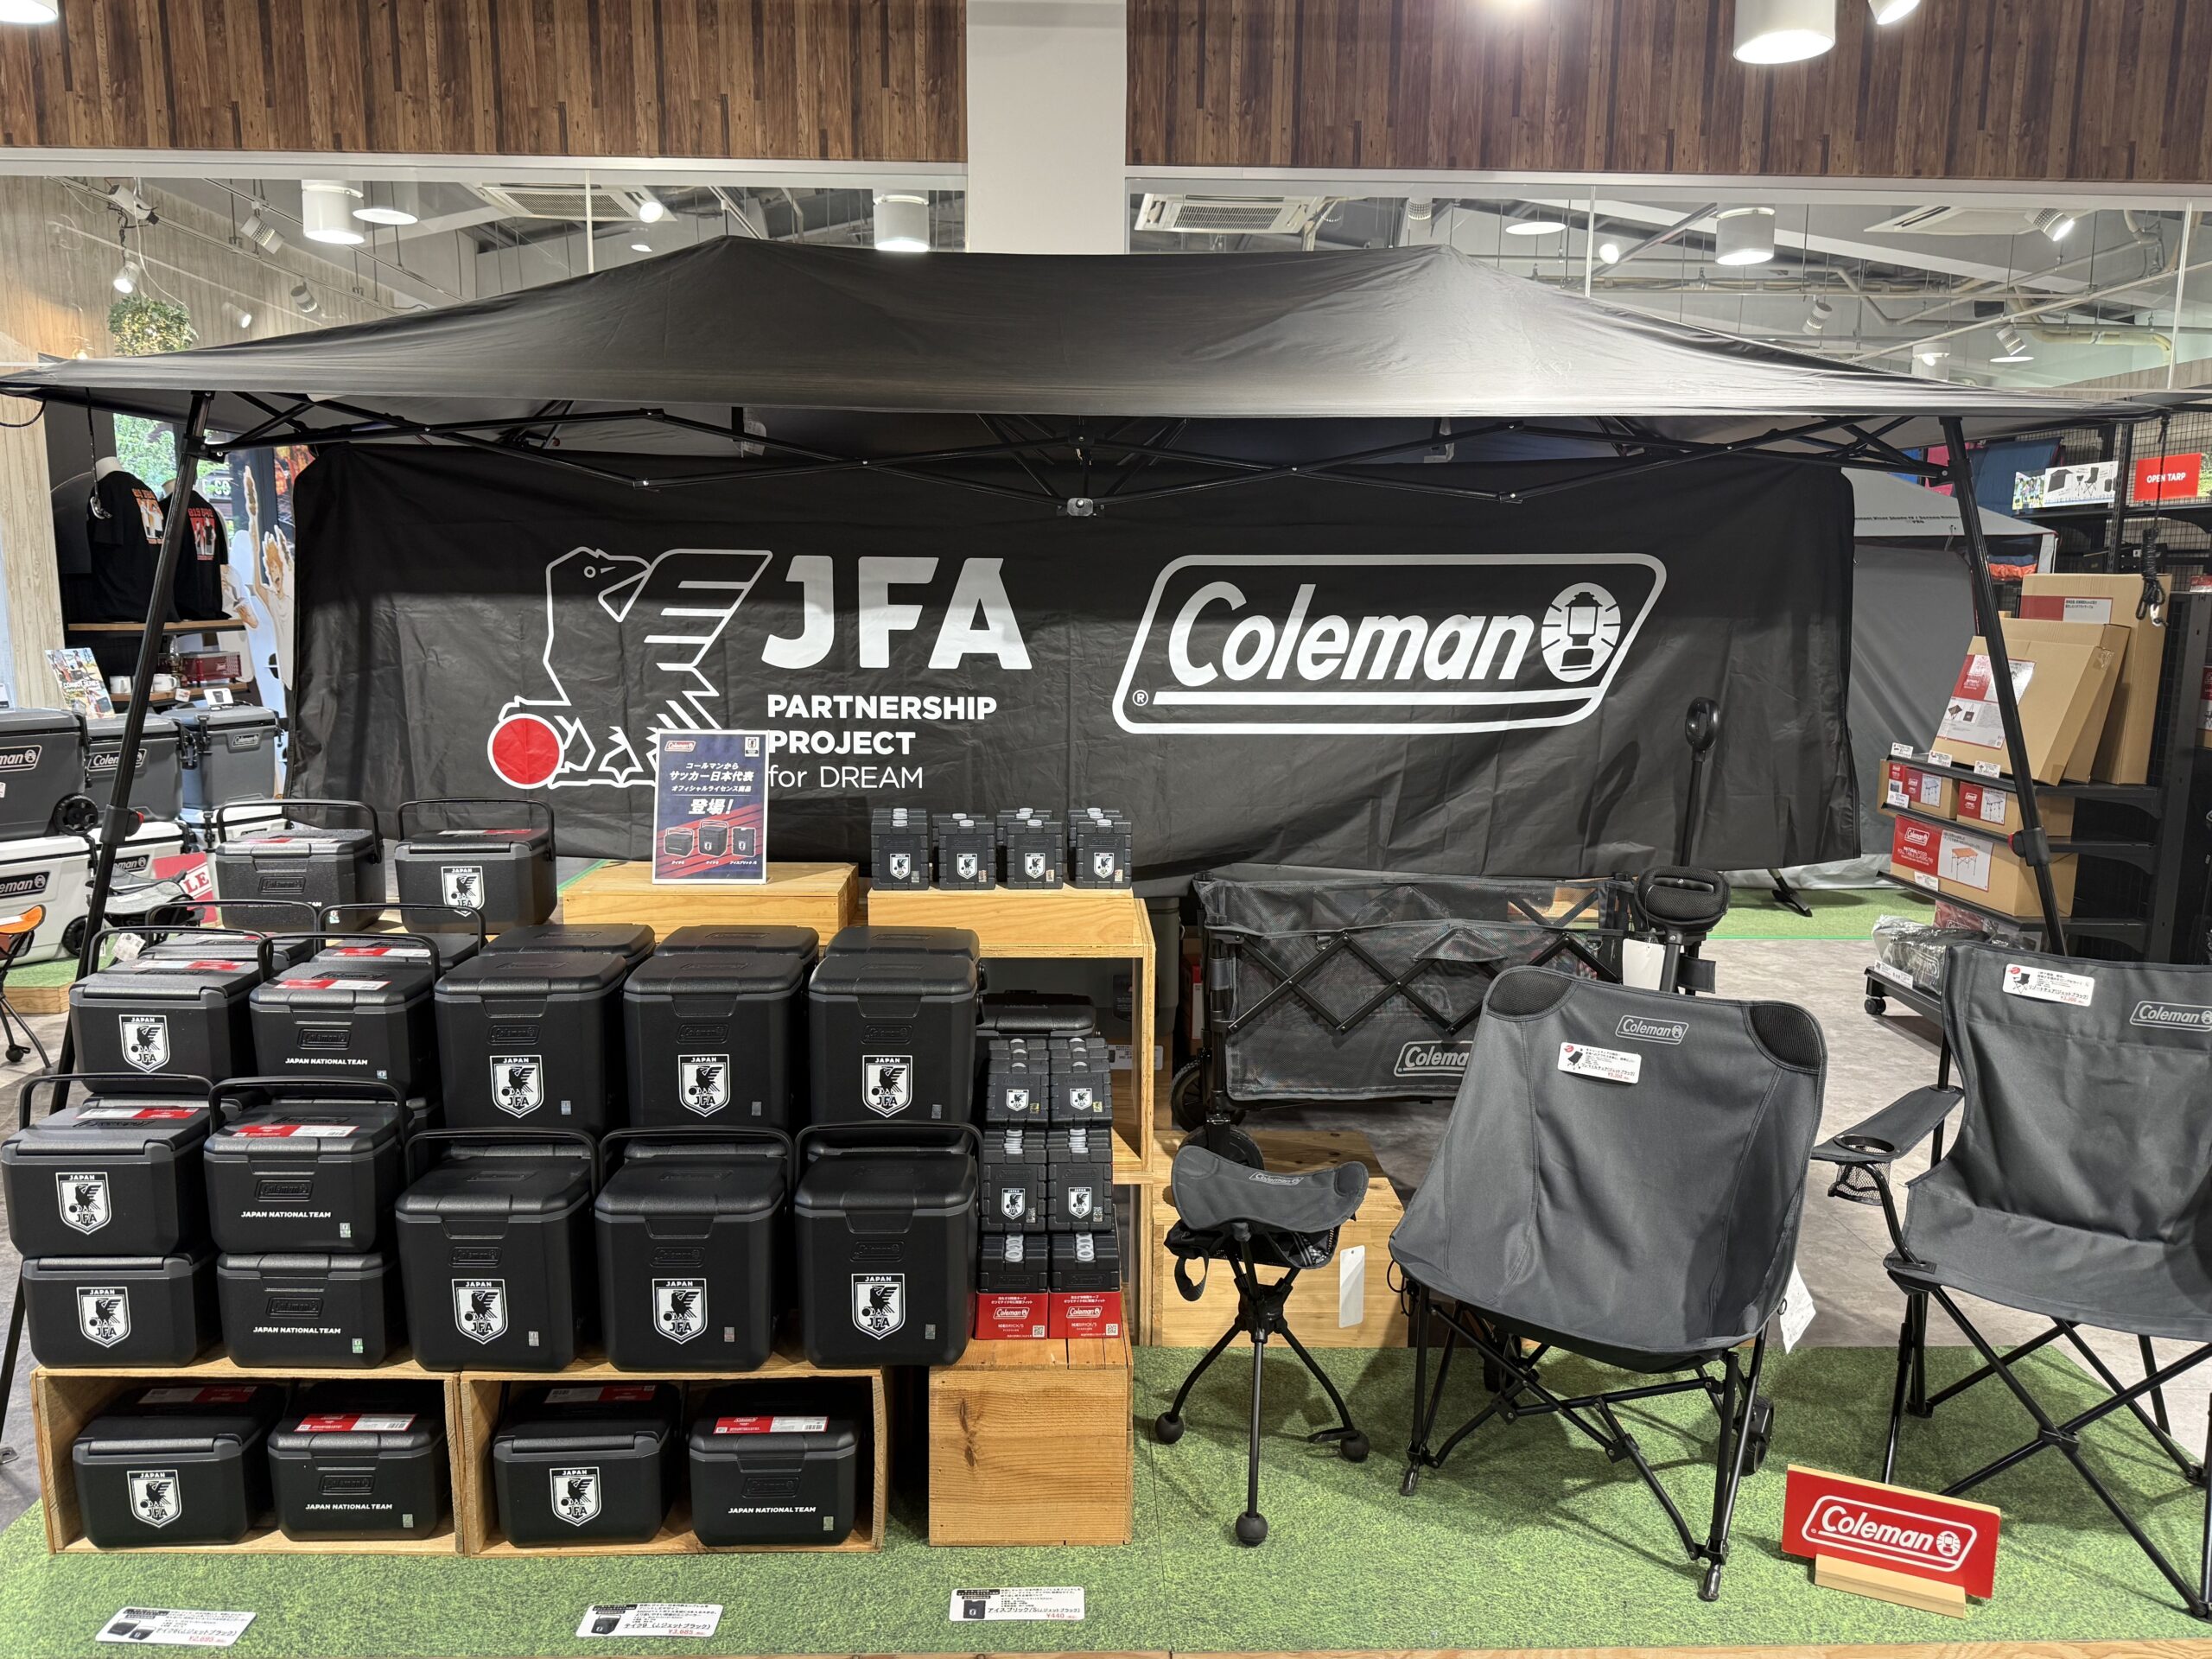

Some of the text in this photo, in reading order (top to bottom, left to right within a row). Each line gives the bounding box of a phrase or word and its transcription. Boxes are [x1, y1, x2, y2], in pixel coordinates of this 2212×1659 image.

[2146, 472, 2186, 483] OPEN TARP
[761, 556, 1032, 670] JFA
[1168, 582, 1535, 687] Coleman
[767, 694, 997, 720] PARTNERSHIP
[768, 730, 916, 755] PROJECT
[670, 770, 754, 782] サッカー日本代表
[768, 766, 923, 789] for DREAM
[0, 880, 33, 893] eman
[2139, 1004, 2200, 1024] Coleman
[1622, 1018, 1671, 1038] Coleman
[137, 1054, 156, 1064] JFA
[1404, 1046, 1469, 1067] Colema
[507, 1096, 530, 1106] JFA
[694, 1095, 716, 1105] JFA
[876, 1096, 898, 1106] JFA
[75, 1214, 98, 1224] JFA
[471, 1322, 493, 1332] JFA
[671, 1322, 693, 1332] JFA
[868, 1317, 890, 1328] JFA
[94, 1326, 117, 1337] JFA
[146, 1508, 168, 1518] JFA
[566, 1506, 588, 1516] JFA
[1821, 1505, 1934, 1551] Coleman
